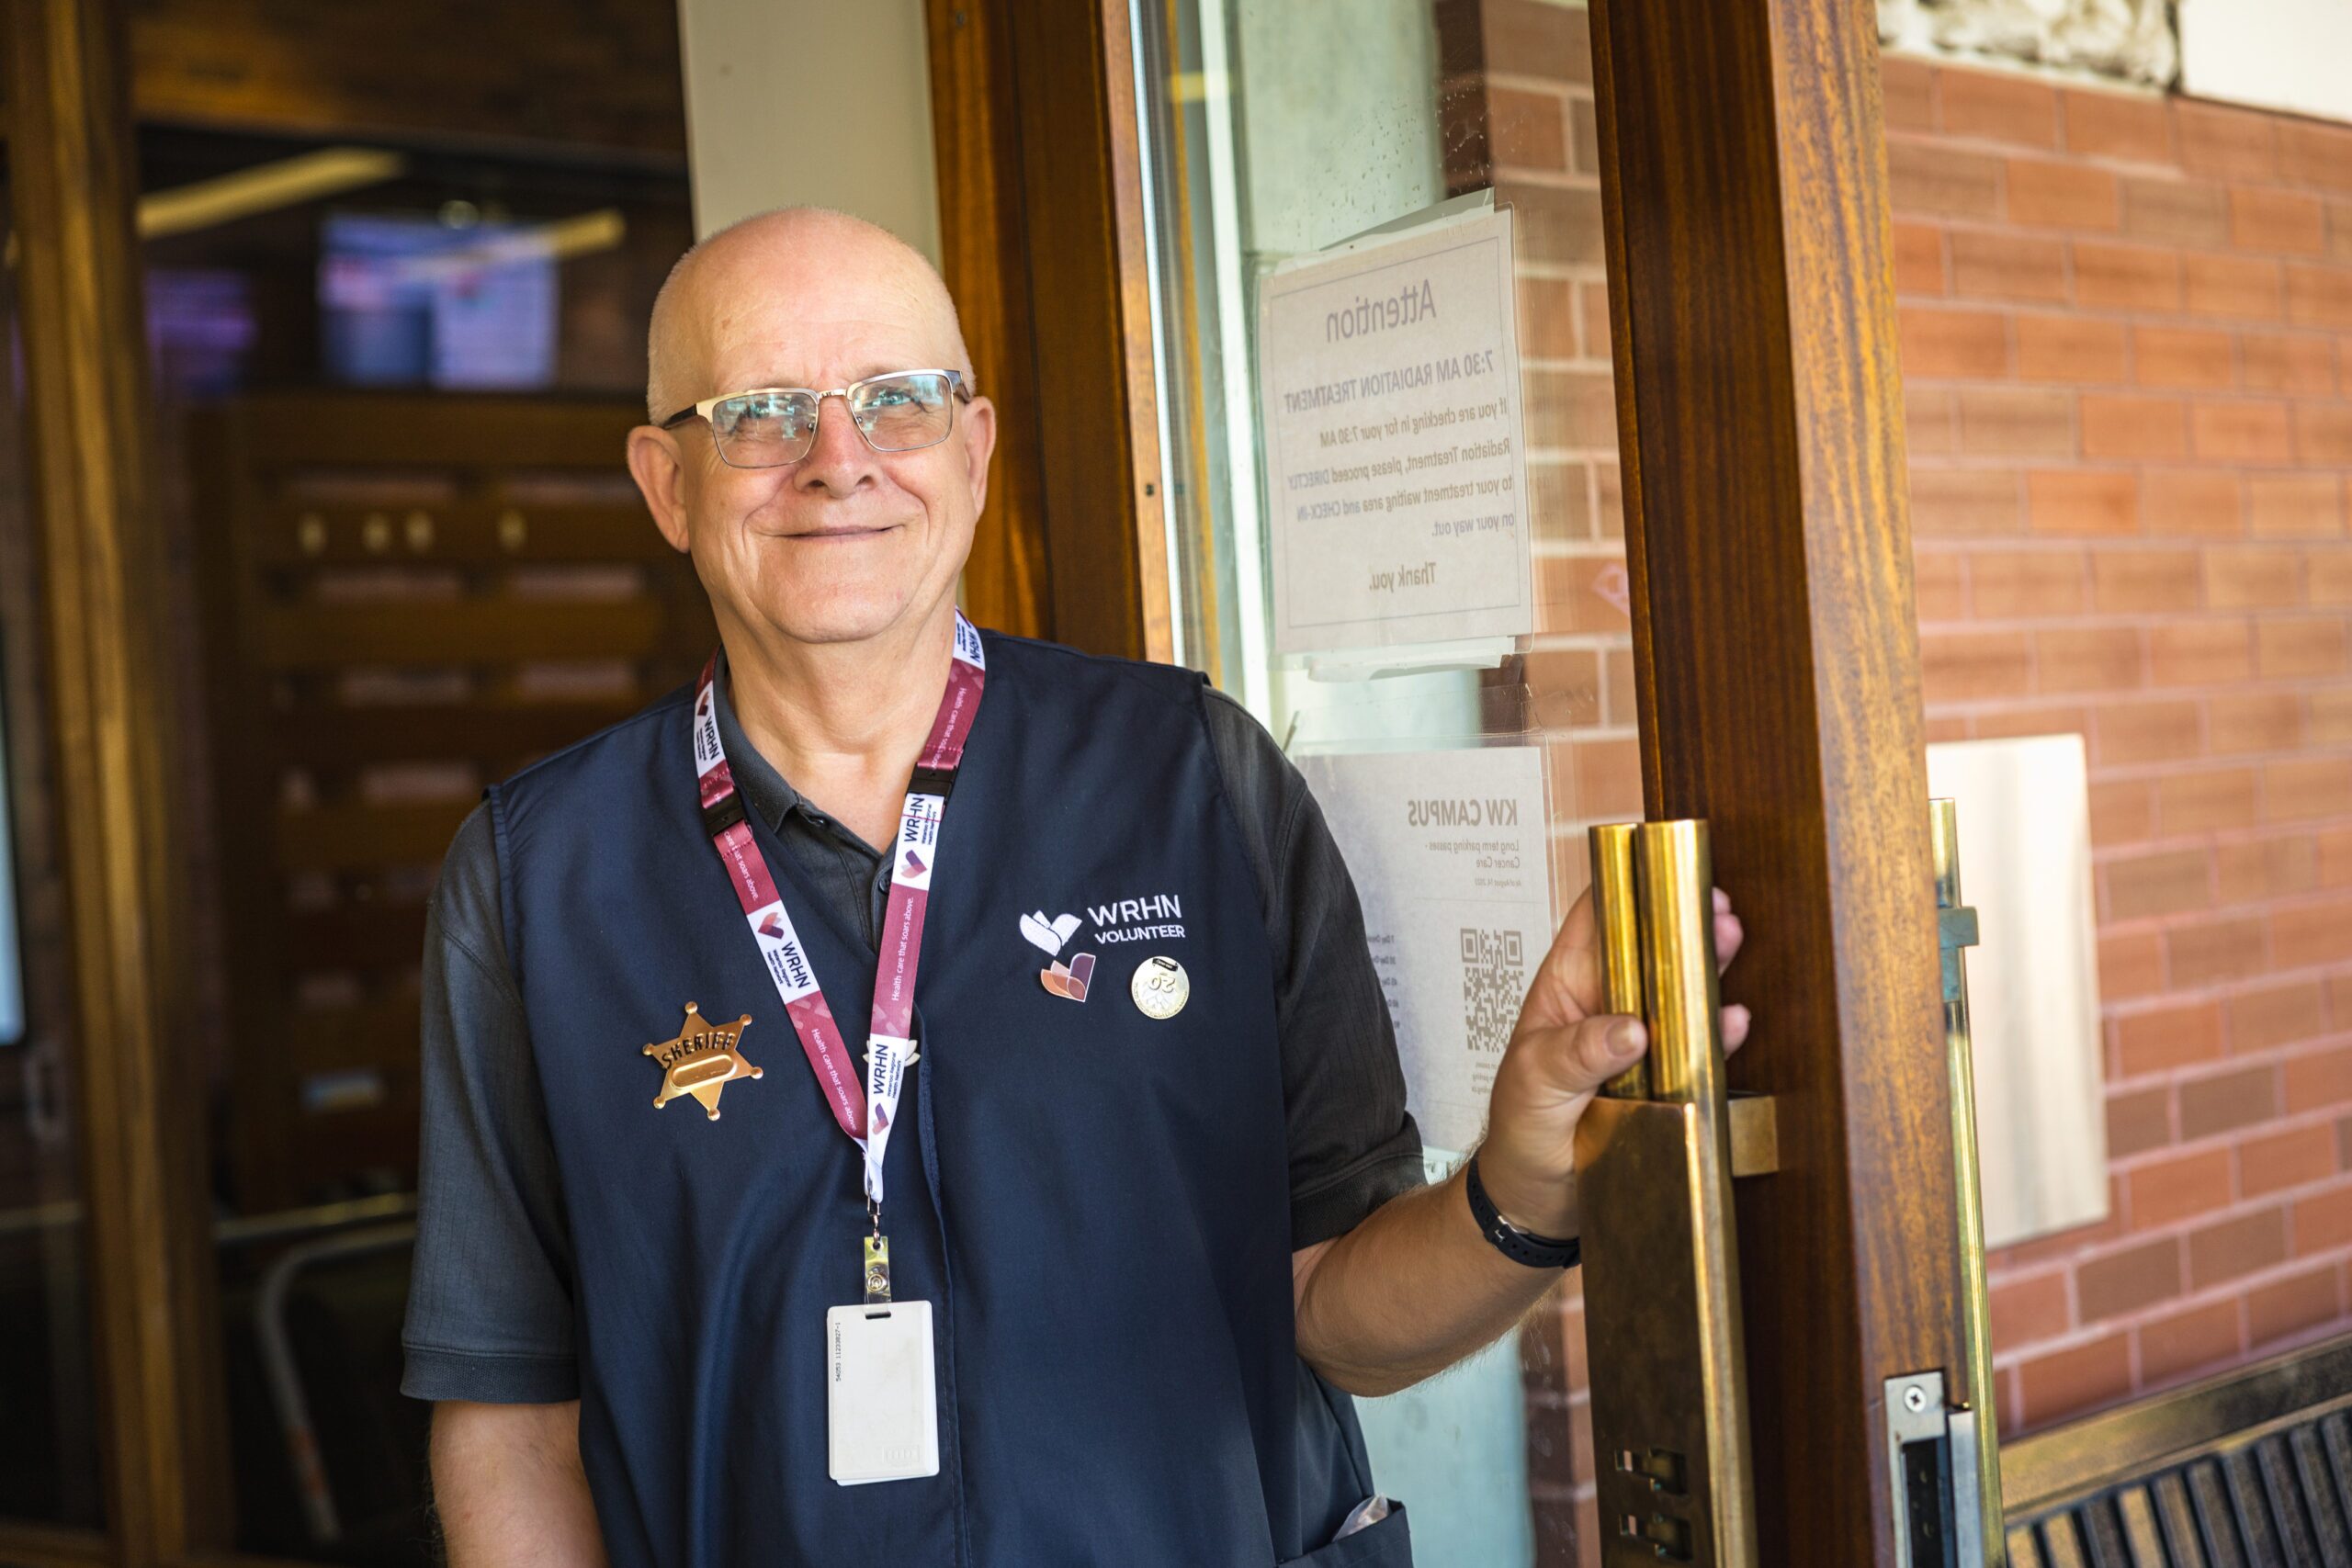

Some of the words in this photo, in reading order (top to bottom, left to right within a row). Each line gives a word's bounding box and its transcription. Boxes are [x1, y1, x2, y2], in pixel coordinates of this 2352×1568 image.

[970, 631, 981, 662] WRHN
[705, 716, 719, 761] WRHN
[904, 796, 925, 842] WRHN
[738, 860, 749, 878] soars
[1088, 895, 1182, 927] WRHN
[901, 921, 910, 940] soars
[1095, 925, 1185, 944] VOLUNTEER
[898, 941, 906, 955] that
[781, 942, 810, 988] WRHN
[891, 976, 901, 1000] Health
[662, 1032, 735, 1070] SHERIFF
[811, 1028, 826, 1052] Health
[823, 1054, 832, 1069] care
[830, 1070, 840, 1085] that
[837, 1086, 848, 1105] soars
[874, 1043, 888, 1094] WRHN
